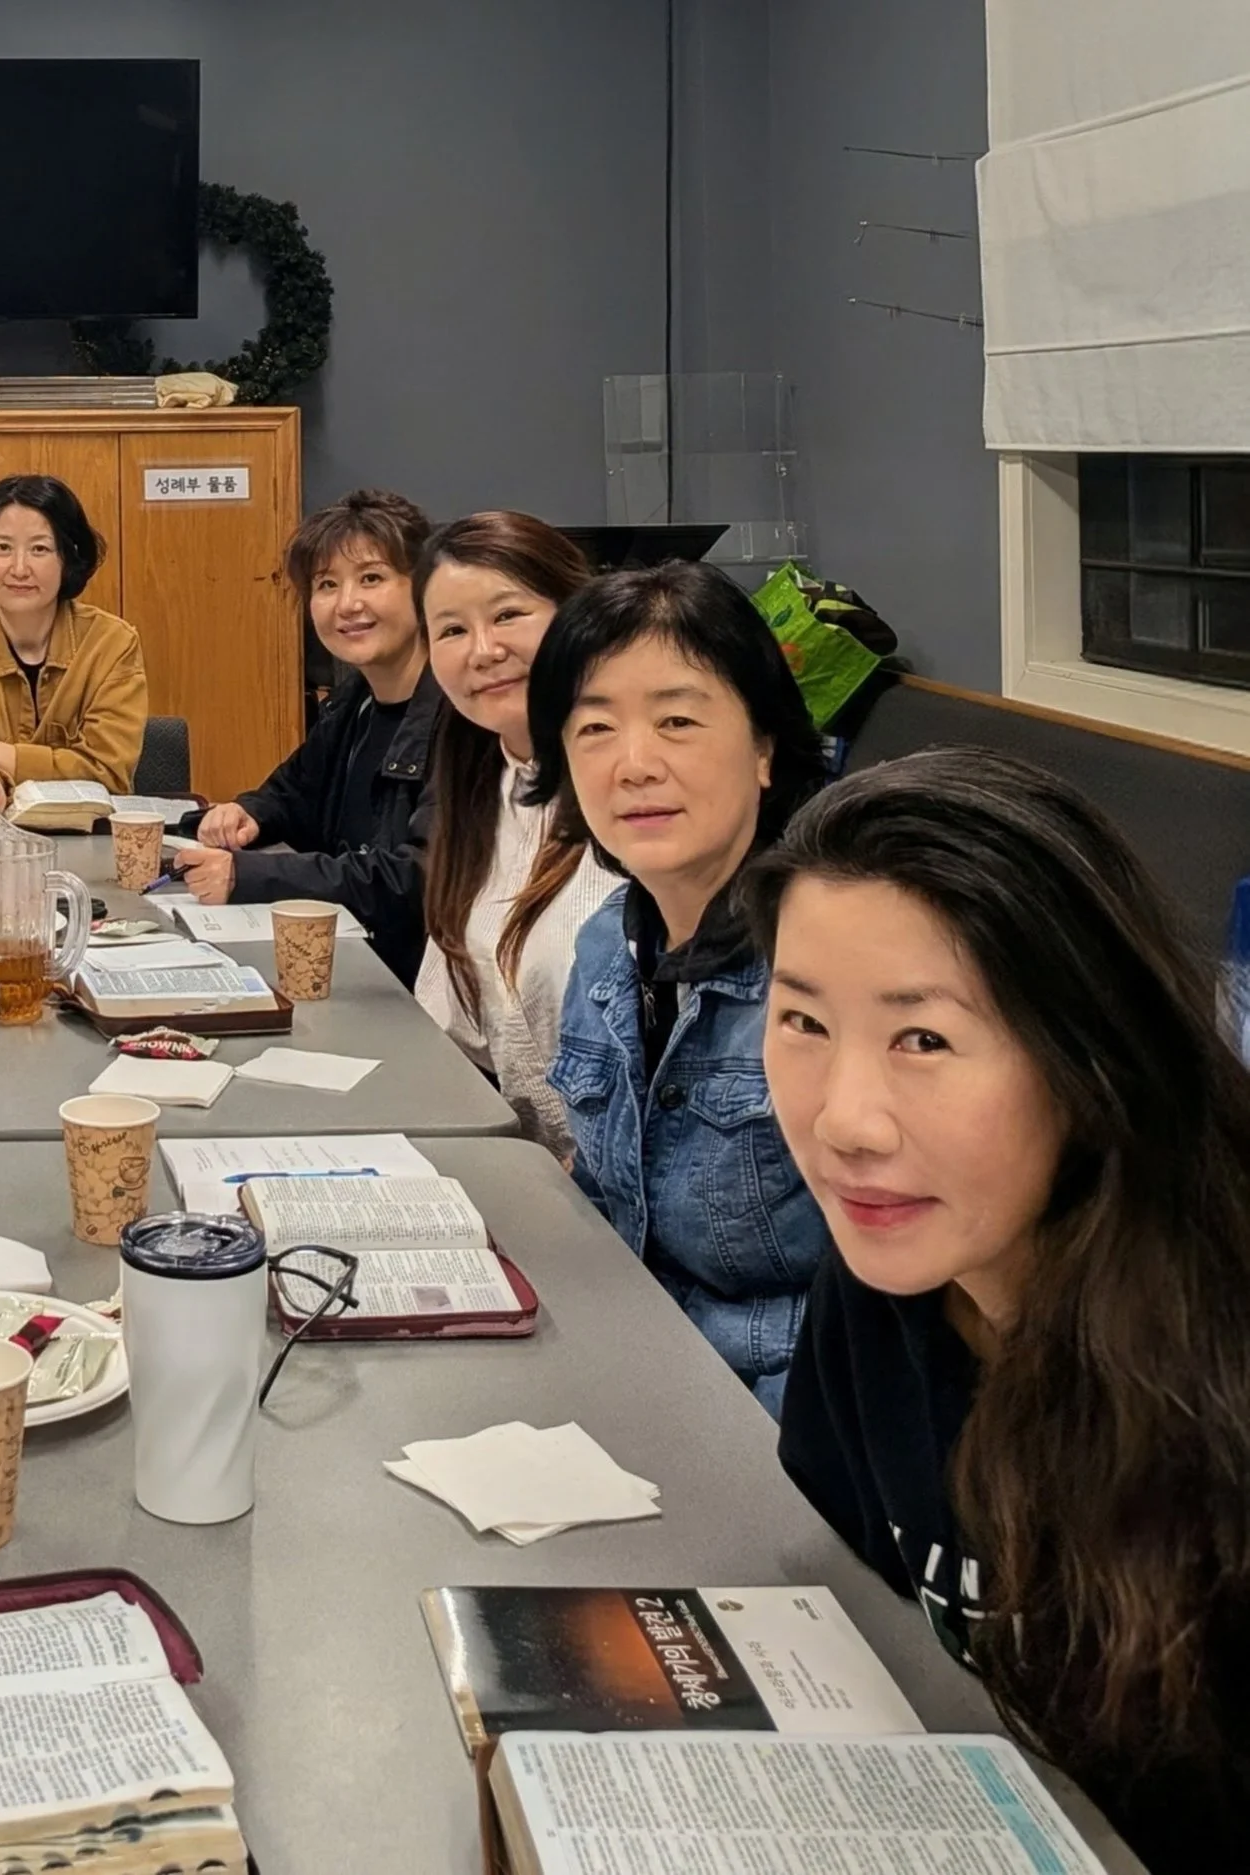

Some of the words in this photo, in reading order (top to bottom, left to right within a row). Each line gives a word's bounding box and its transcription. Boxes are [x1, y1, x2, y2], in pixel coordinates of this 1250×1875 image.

[155, 477, 201, 495] 성례부
[206, 476, 238, 493] 물품
[77, 1131, 128, 1156] Espresso
[635, 1597, 665, 1609] 2
[639, 1610, 685, 1642] 발견
[656, 1644, 721, 1710] 창세기의
